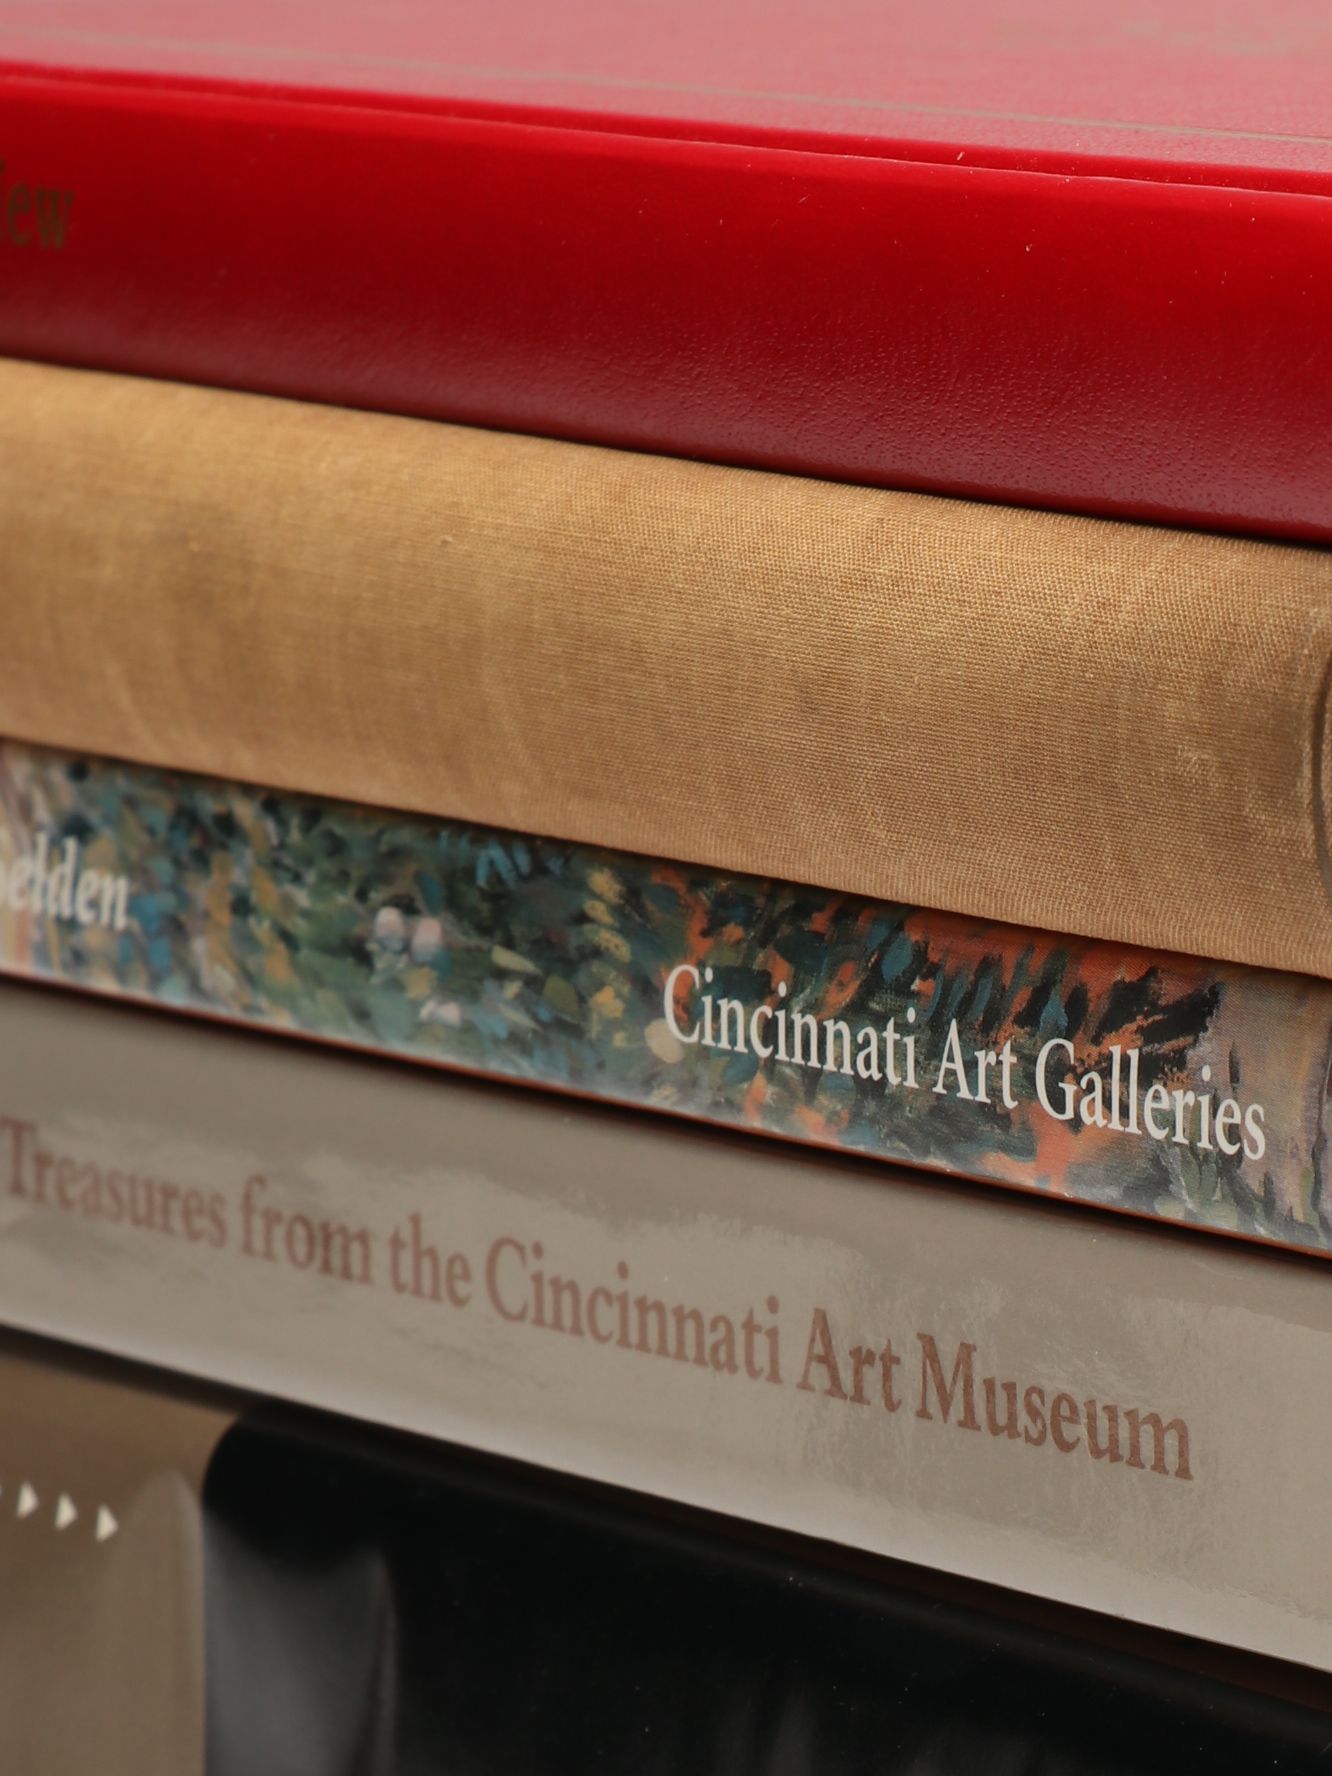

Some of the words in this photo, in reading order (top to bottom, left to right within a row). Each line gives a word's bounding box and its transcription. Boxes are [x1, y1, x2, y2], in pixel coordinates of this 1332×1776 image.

[0, 157, 75, 250] ew
[0, 831, 129, 931] elden
[663, 963, 918, 1089] Cincinnati
[931, 1017, 1019, 1109] Art
[1034, 1038, 1267, 1162] Galleries
[2, 1115, 227, 1251] Treasures
[240, 1173, 375, 1287] from
[388, 1211, 473, 1309] the
[486, 1236, 784, 1385] Cincinnati
[796, 1306, 902, 1414] Art
[915, 1331, 1195, 1481] Museum
